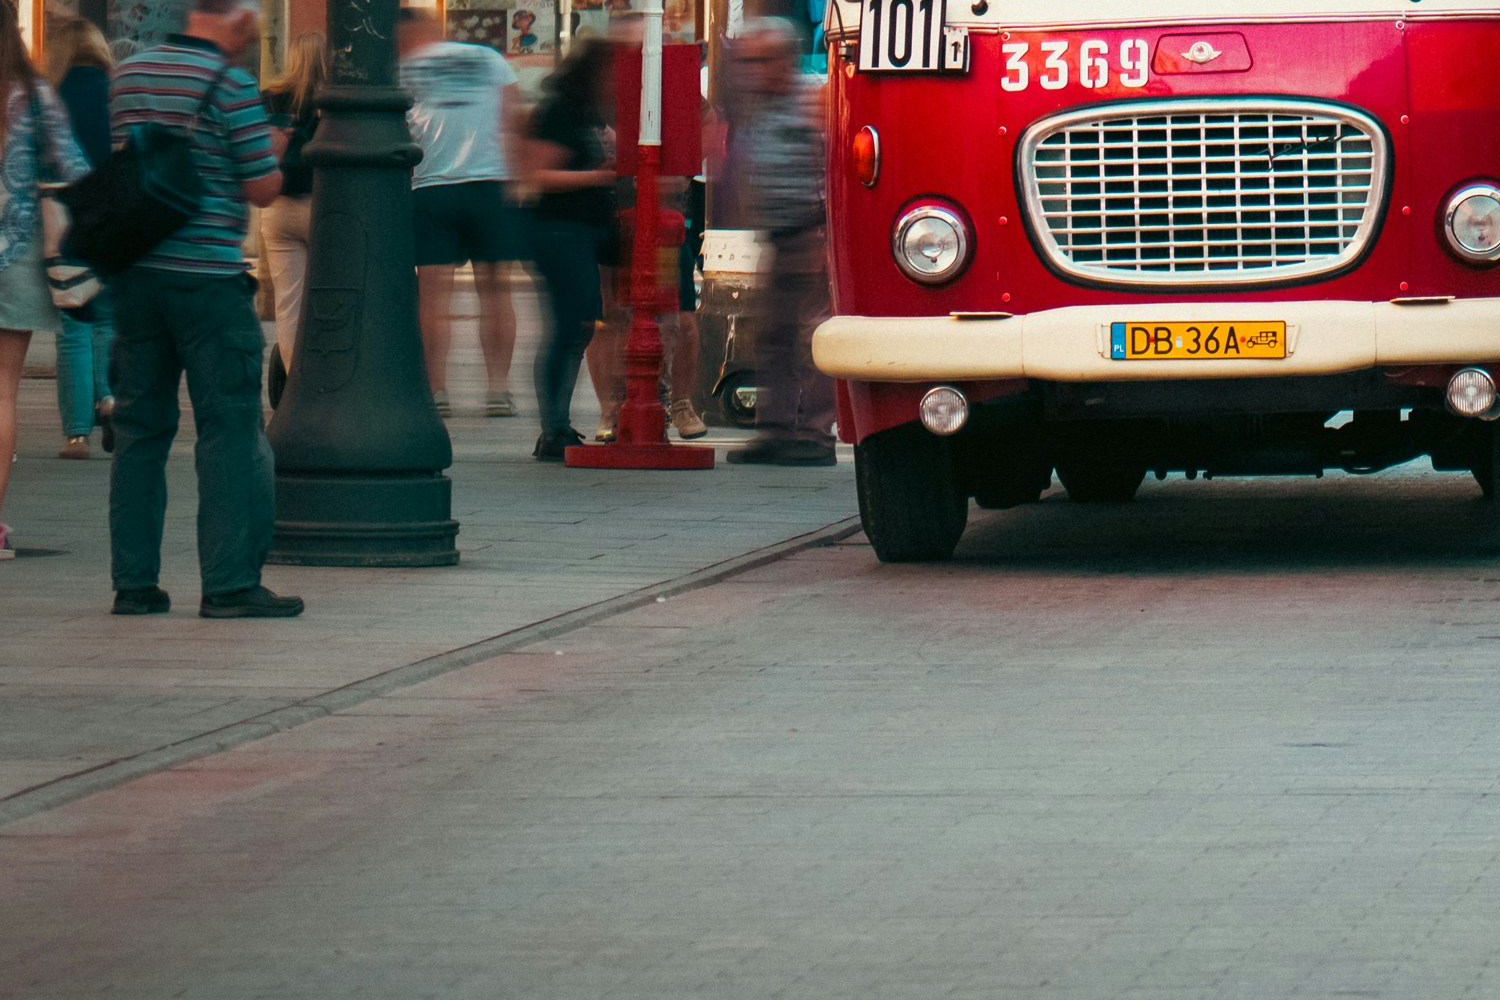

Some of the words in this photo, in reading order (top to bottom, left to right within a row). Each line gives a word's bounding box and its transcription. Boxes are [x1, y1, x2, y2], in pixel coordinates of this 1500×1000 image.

[951, 41, 962, 62] 1
[1000, 38, 1150, 93] 3369
[1113, 344, 1125, 353] PL
[1130, 326, 1173, 356] DB
[1186, 325, 1241, 355] 36A
